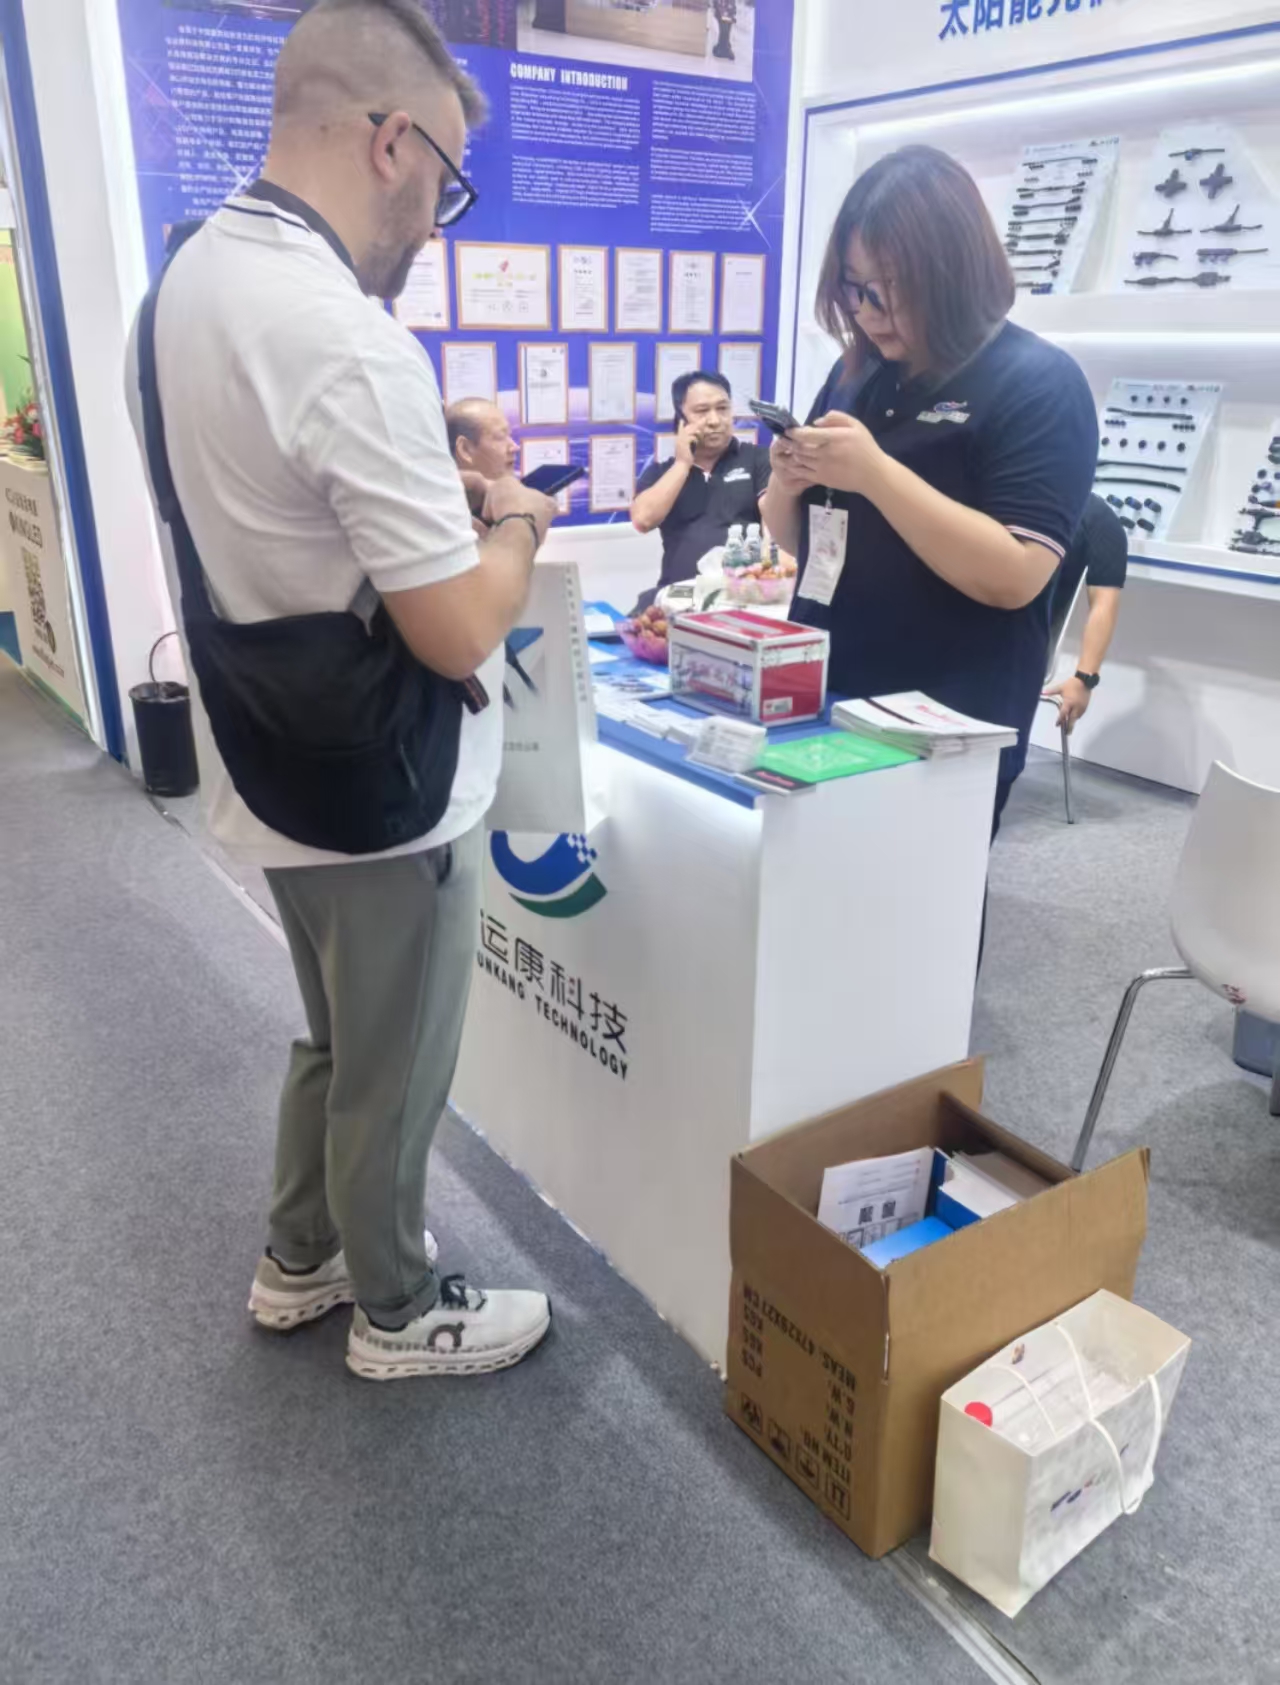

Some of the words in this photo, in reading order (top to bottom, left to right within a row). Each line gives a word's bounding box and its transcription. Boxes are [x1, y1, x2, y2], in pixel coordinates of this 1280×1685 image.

[510, 62, 556, 83] COMPANY
[560, 68, 628, 91] INTRODUCTION
[480, 909, 628, 1054] 运康科技
[535, 995, 628, 1080] TECHNOLOGY
[823, 1450, 850, 1483] ITEM
